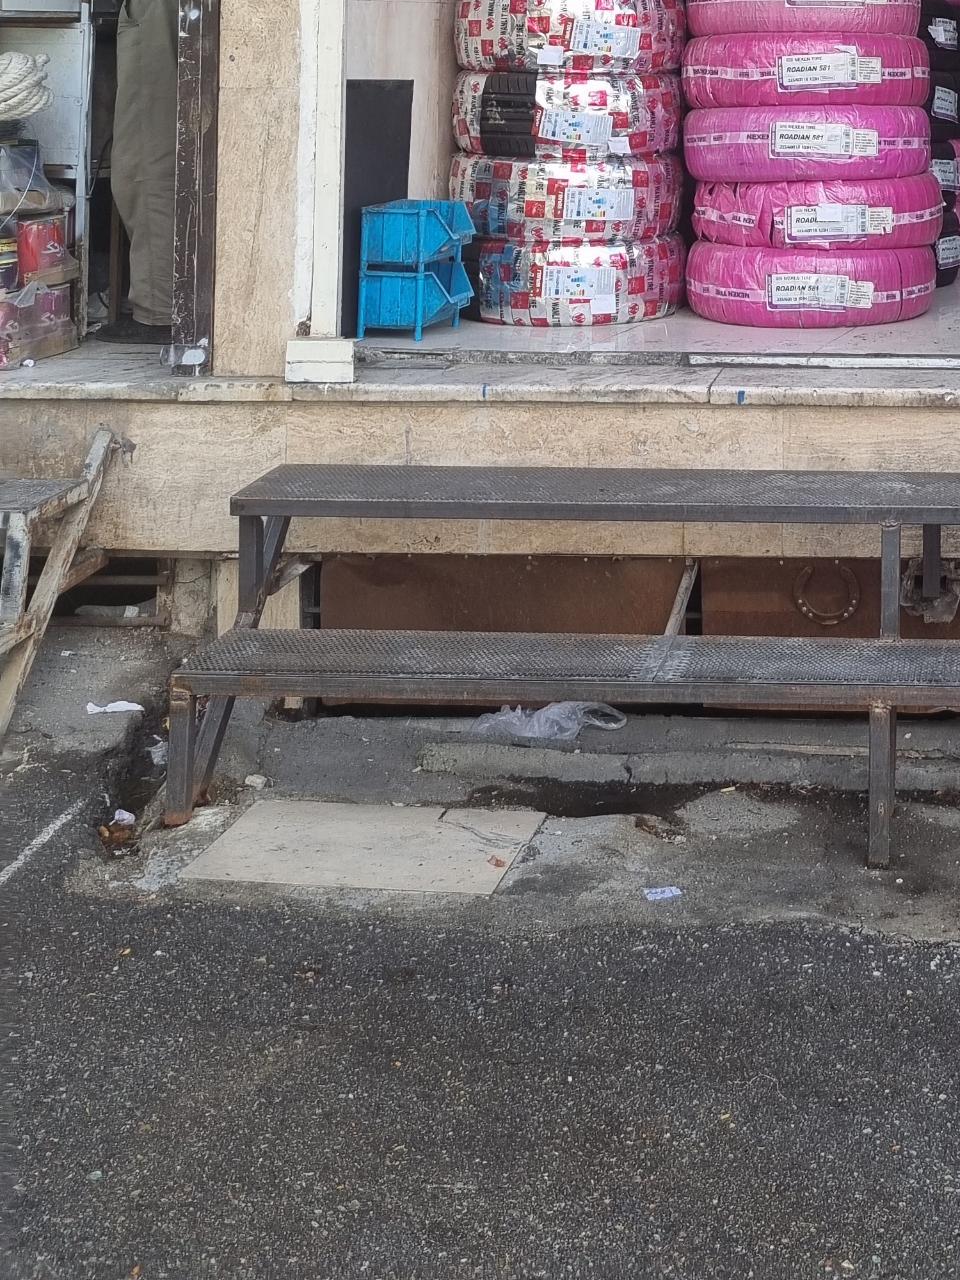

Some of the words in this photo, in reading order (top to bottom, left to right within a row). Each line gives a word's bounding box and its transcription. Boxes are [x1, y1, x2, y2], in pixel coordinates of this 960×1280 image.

[786, 65, 818, 73] ROADIAN
[779, 133, 811, 141] ROADIAN
[775, 285, 806, 293] ROADIAN
